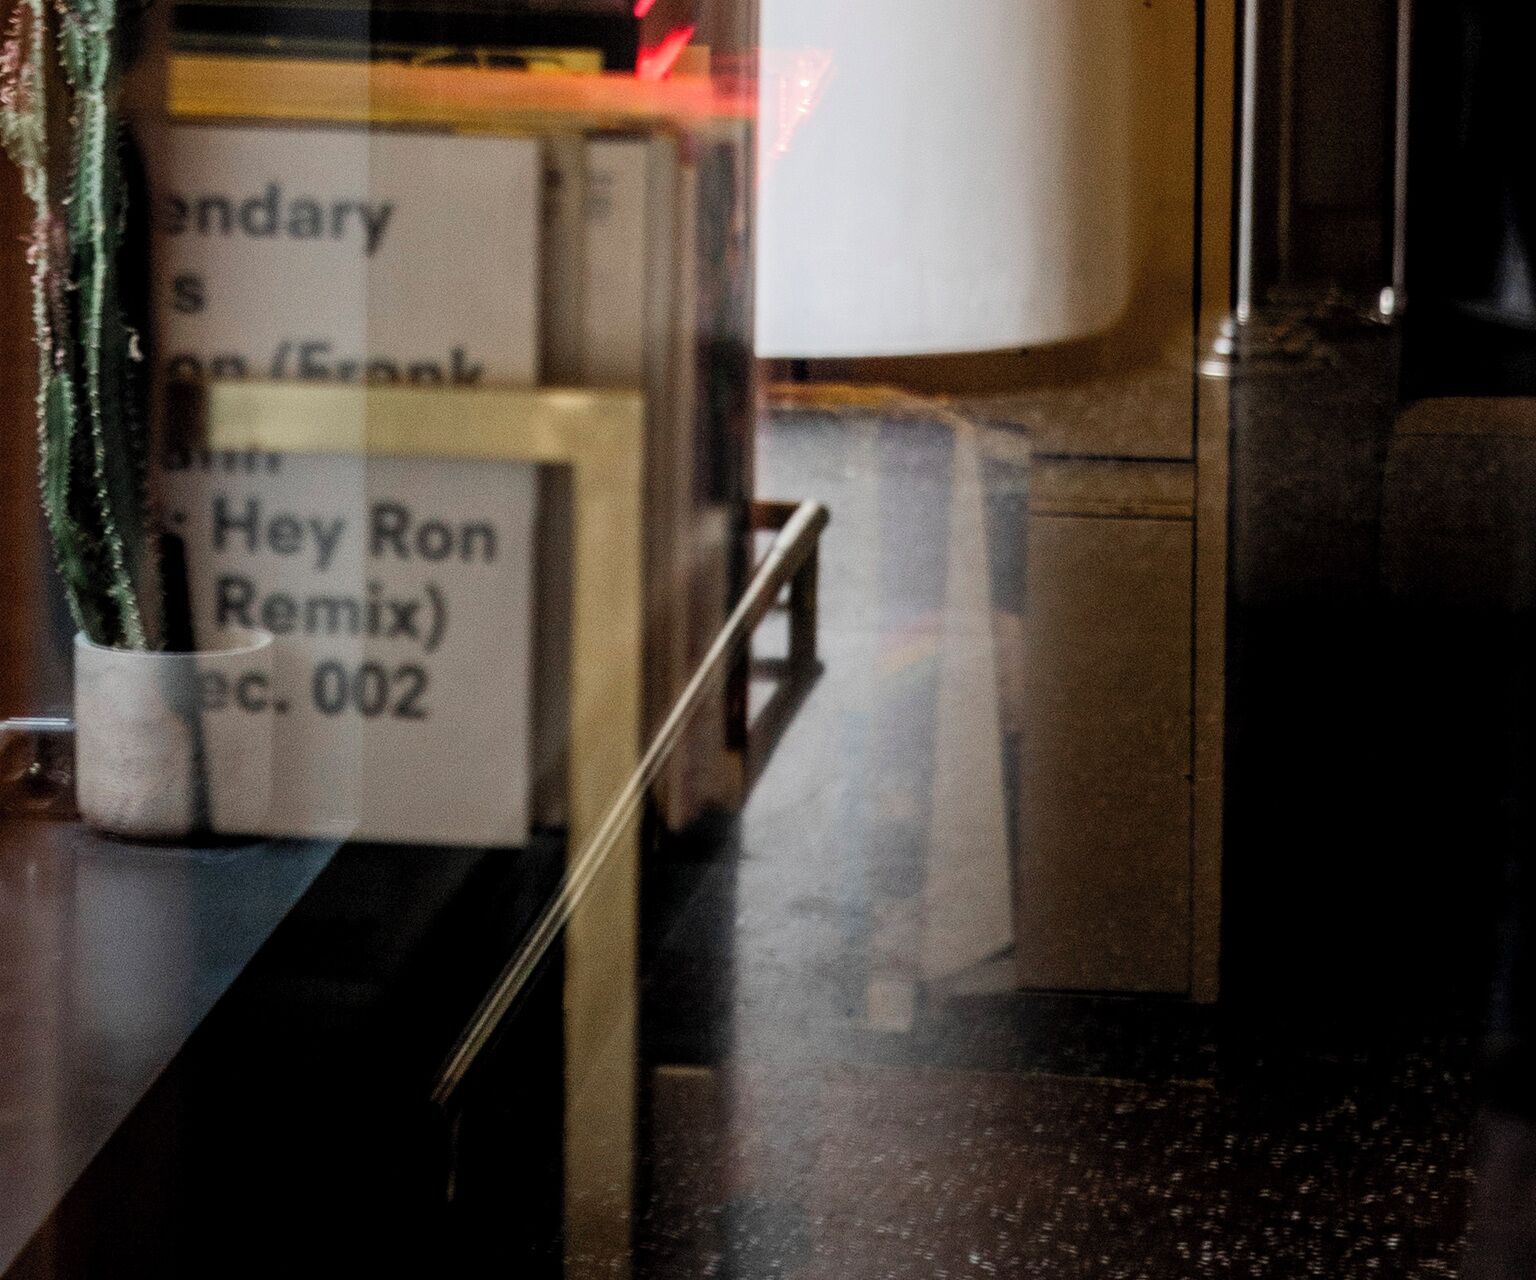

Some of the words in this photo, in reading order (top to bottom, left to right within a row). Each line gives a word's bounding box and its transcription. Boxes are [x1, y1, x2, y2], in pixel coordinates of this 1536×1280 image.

[211, 496, 345, 571] Hey
[369, 500, 498, 562] Ron
[215, 573, 449, 655] Remix)
[311, 659, 429, 720] 002
